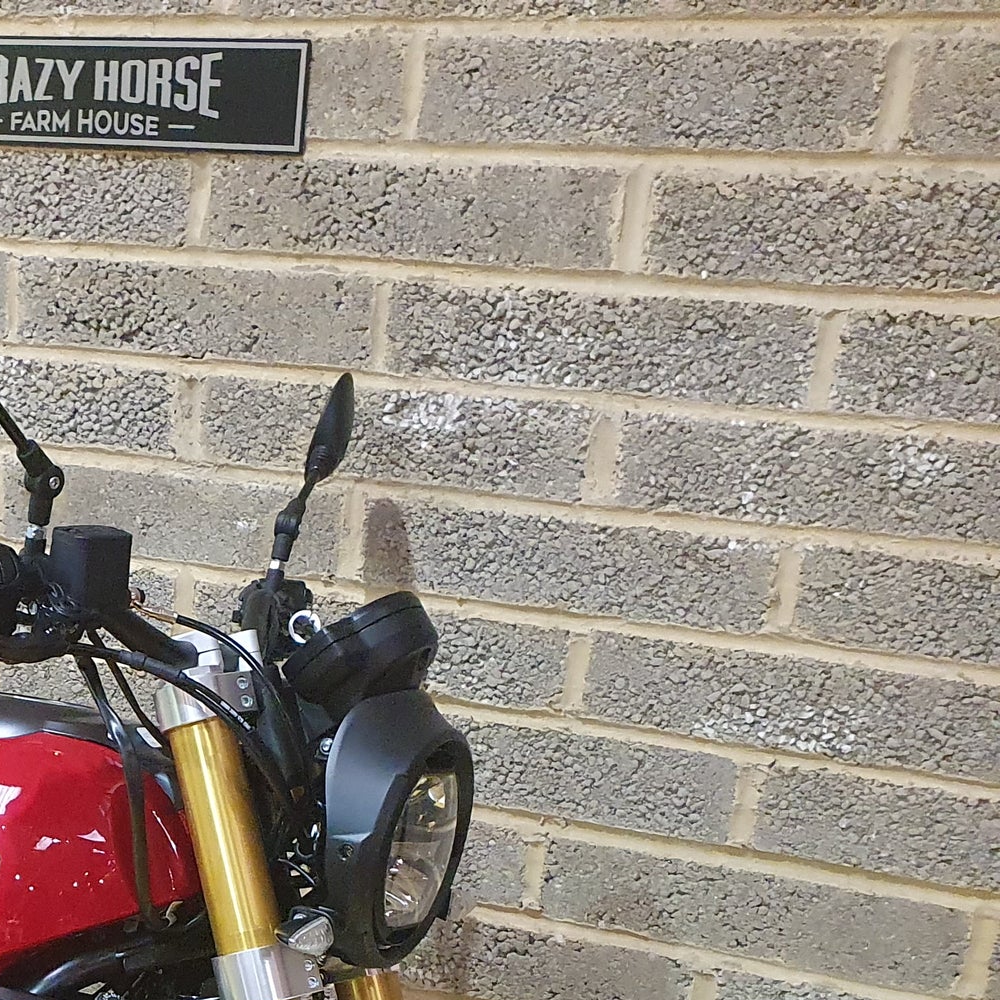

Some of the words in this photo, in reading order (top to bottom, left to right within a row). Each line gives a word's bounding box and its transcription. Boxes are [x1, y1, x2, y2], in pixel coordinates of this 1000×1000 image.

[94, 51, 223, 119] HORSE
[10, 109, 71, 134] FARM
[77, 109, 160, 136] HOUSE
